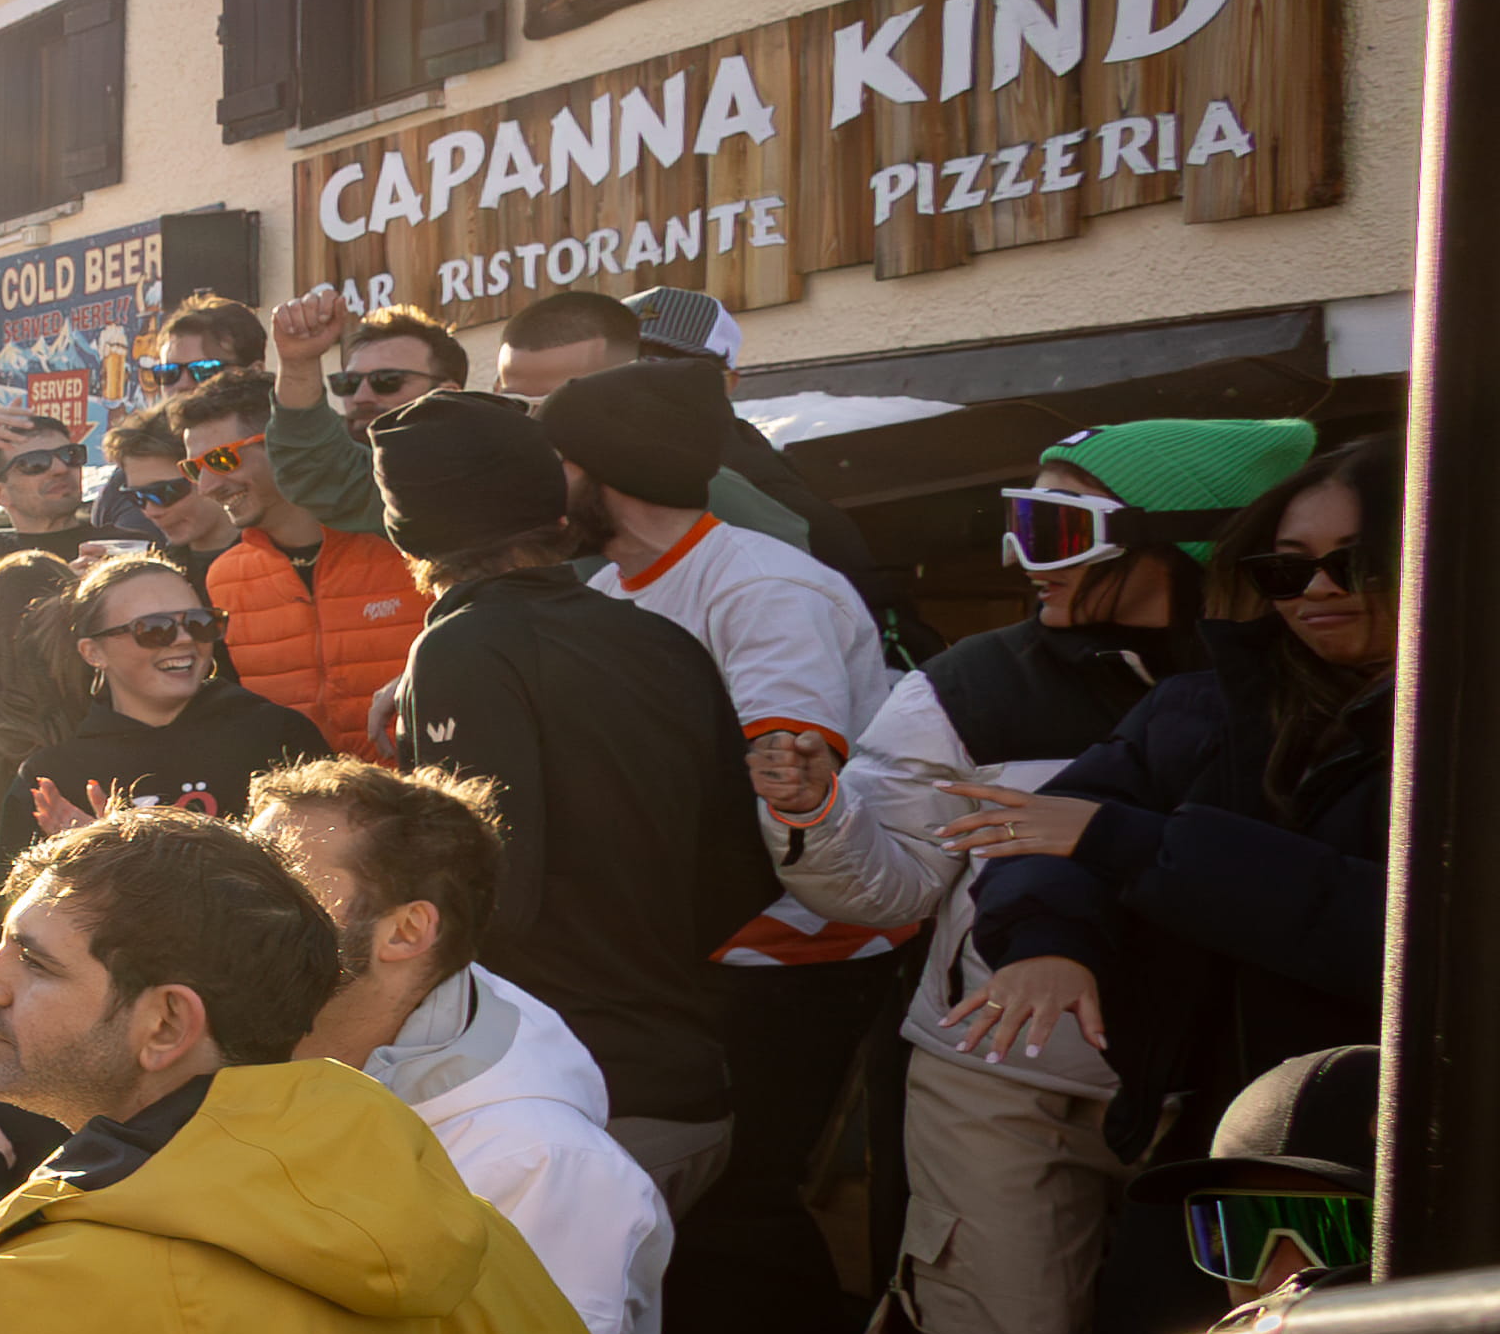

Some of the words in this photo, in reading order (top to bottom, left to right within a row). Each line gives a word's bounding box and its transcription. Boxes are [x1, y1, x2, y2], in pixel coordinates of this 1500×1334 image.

[318, 55, 775, 241] CAPANNA
[437, 196, 787, 305] RISTORANTE
[871, 99, 1256, 226] PIZZERIA
[2, 256, 75, 311] COLD
[3, 312, 63, 344] SERVED
[31, 378, 83, 401] SERVED
